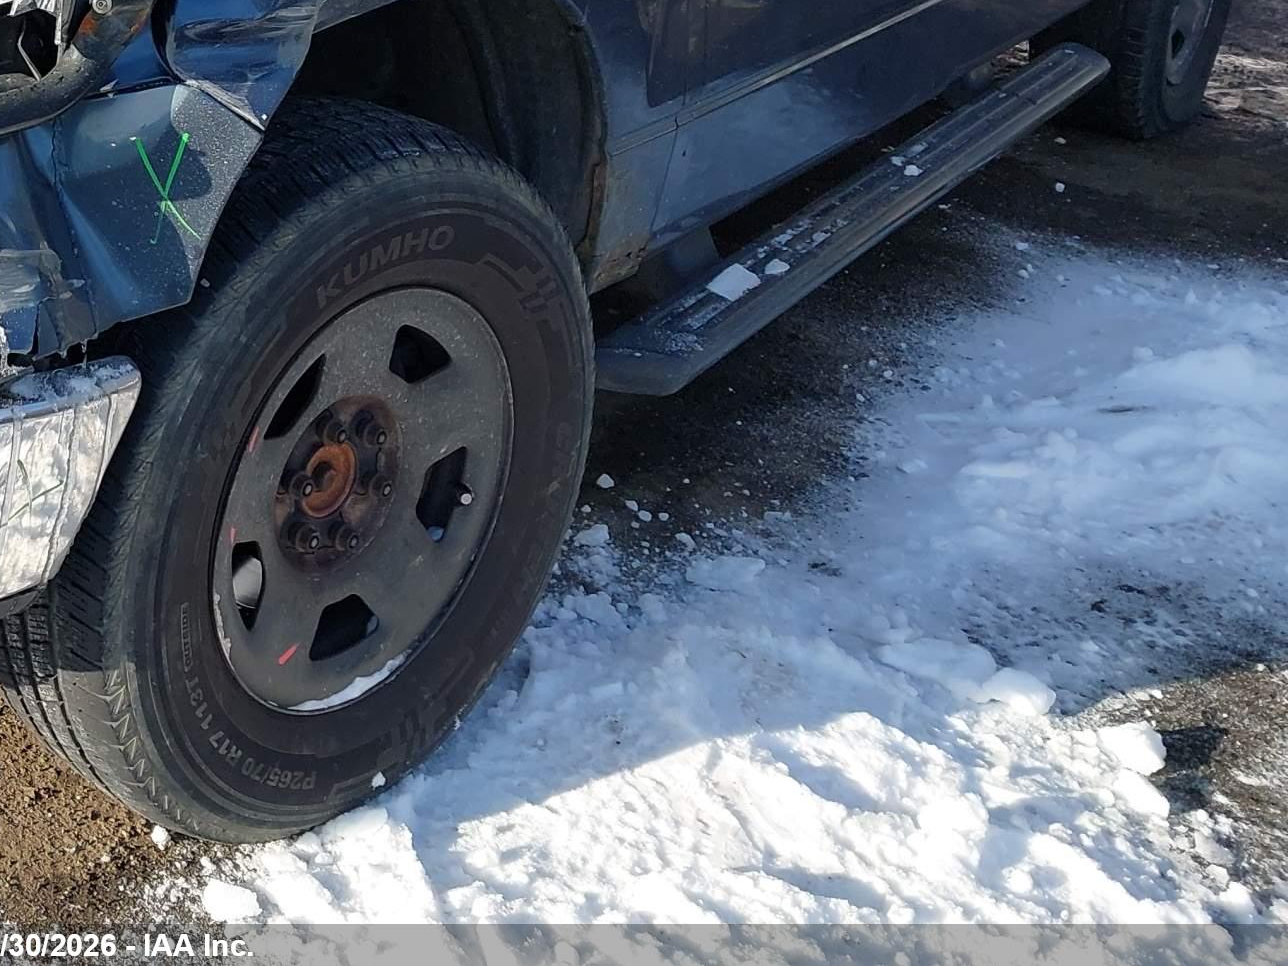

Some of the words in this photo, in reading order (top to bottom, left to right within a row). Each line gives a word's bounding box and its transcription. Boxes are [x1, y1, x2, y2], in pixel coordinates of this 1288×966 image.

[316, 225, 455, 308] KUMHO
[185, 677, 214, 730] 113T
[207, 731, 244, 767] R17
[240, 756, 318, 790] P265/70
